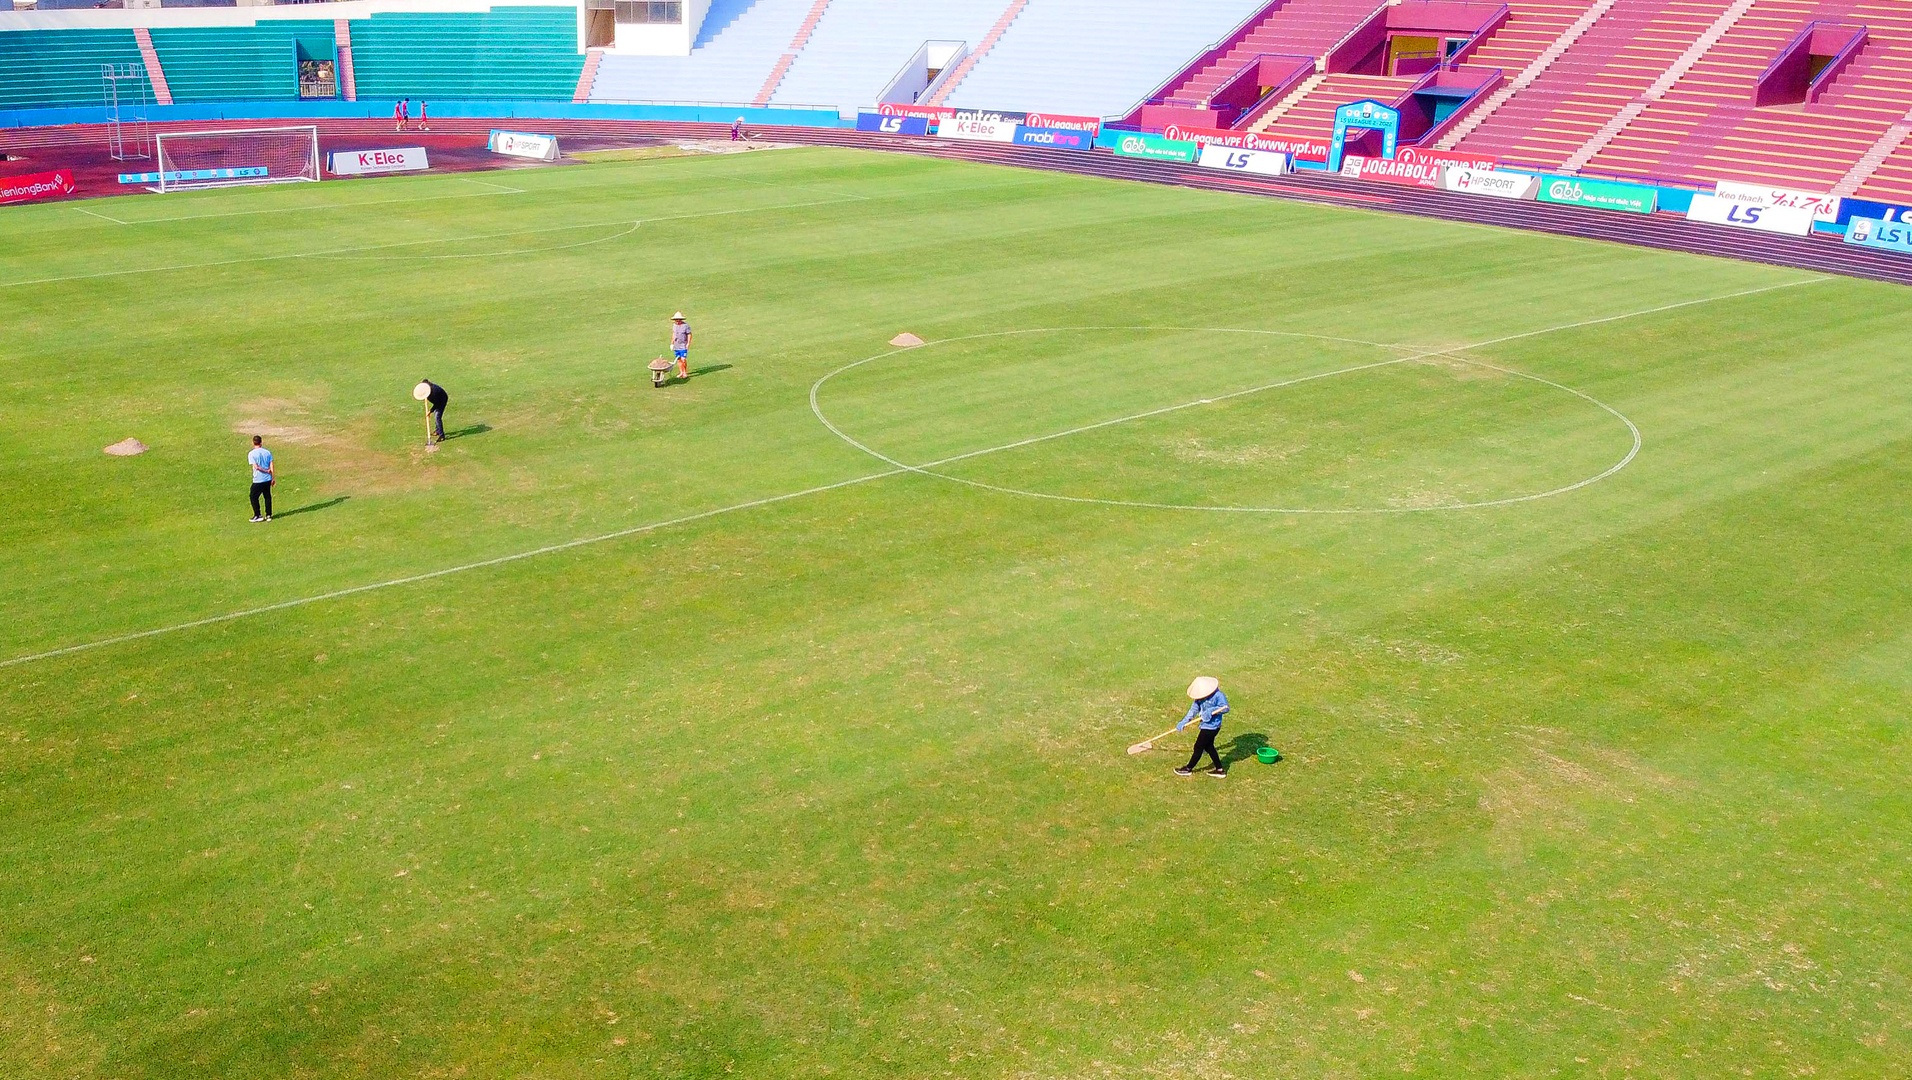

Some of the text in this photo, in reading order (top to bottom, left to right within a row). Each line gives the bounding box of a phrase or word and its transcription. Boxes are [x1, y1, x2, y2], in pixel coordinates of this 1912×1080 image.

[880, 118, 902, 132] LS
[957, 121, 995, 134] K-Elec
[1023, 131, 1080, 146] mobifone
[1259, 139, 1326, 156] www.vpf.vn
[358, 152, 405, 166] K-Elec
[1226, 152, 1250, 168] LS
[1362, 159, 1438, 180] JOGARBOLA
[1471, 176, 1515, 190] HPSPORT
[1727, 205, 1762, 224] LS
[1876, 227, 1901, 242] LS
